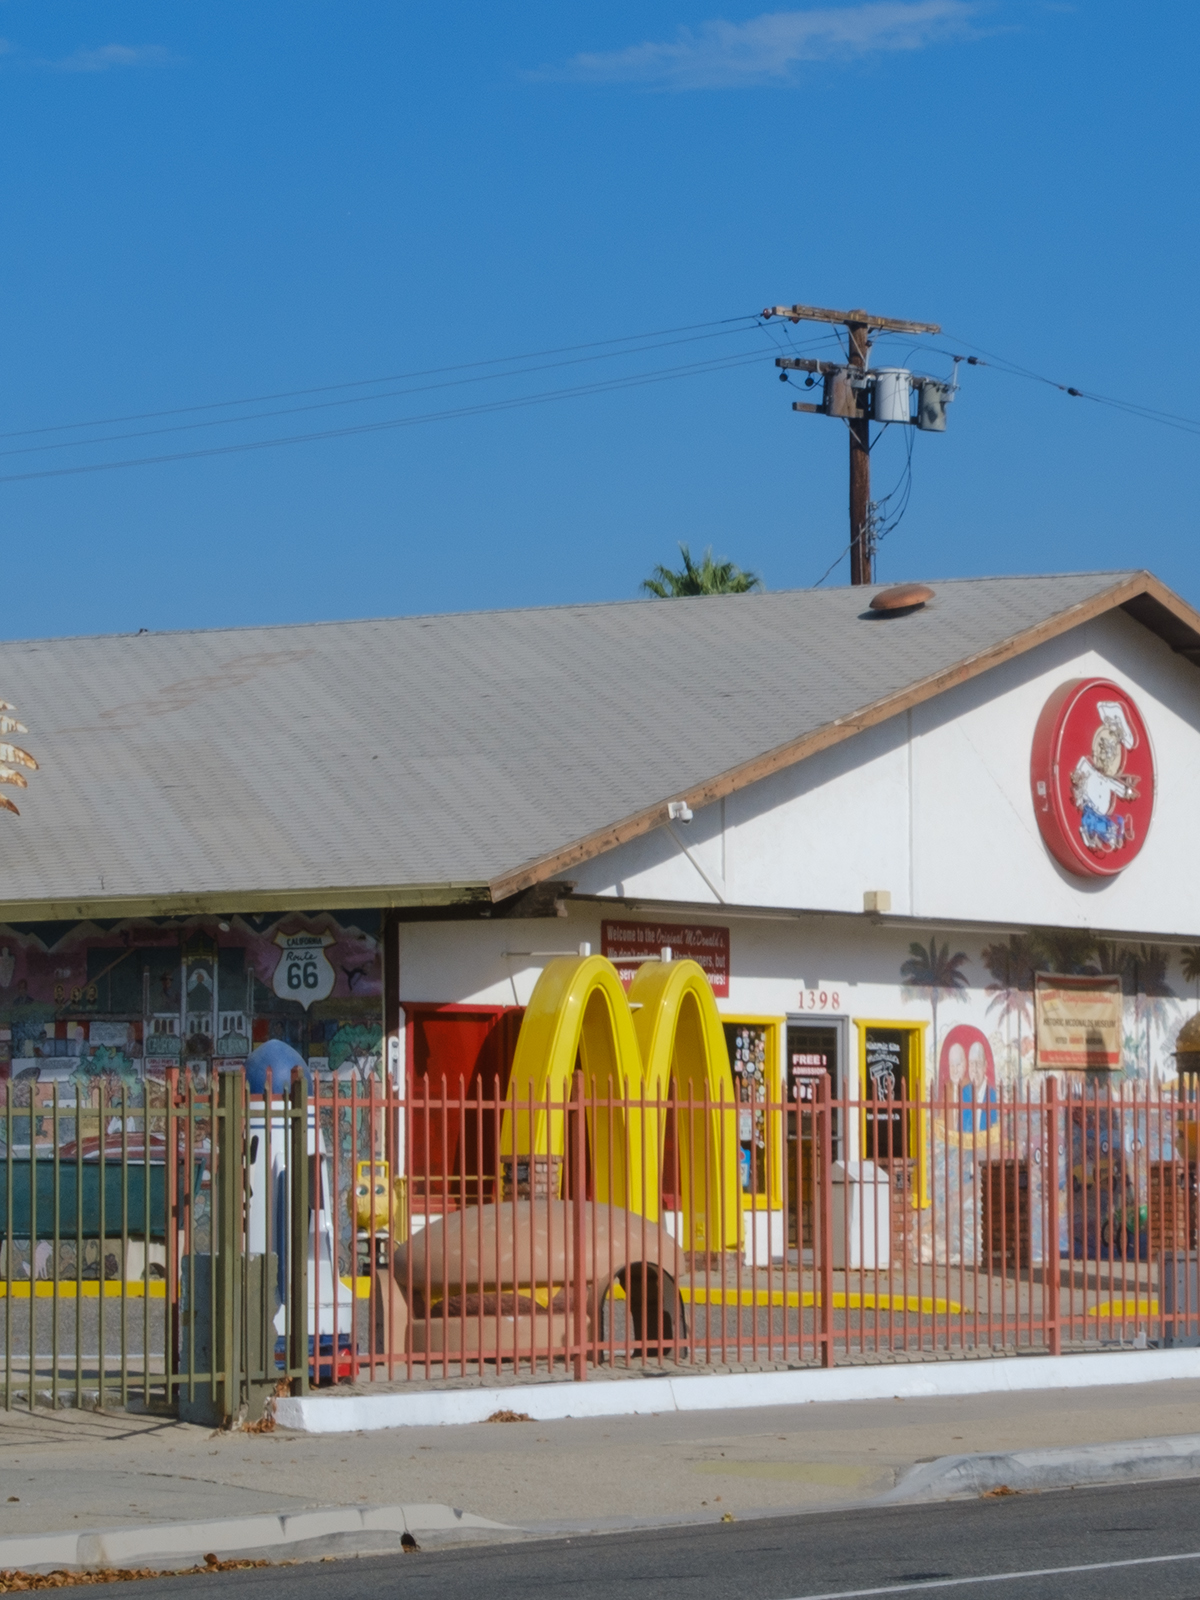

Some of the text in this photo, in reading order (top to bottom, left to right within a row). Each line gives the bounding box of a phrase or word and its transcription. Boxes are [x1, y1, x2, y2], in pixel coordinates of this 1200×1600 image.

[286, 937, 323, 947] CALIFORNIA
[607, 925, 636, 942] Welcome
[637, 927, 644, 942] to
[645, 927, 655, 943] the
[656, 928, 684, 946] Original
[286, 951, 317, 961] Route
[287, 961, 319, 990] 66
[798, 990, 841, 1011] 1398
